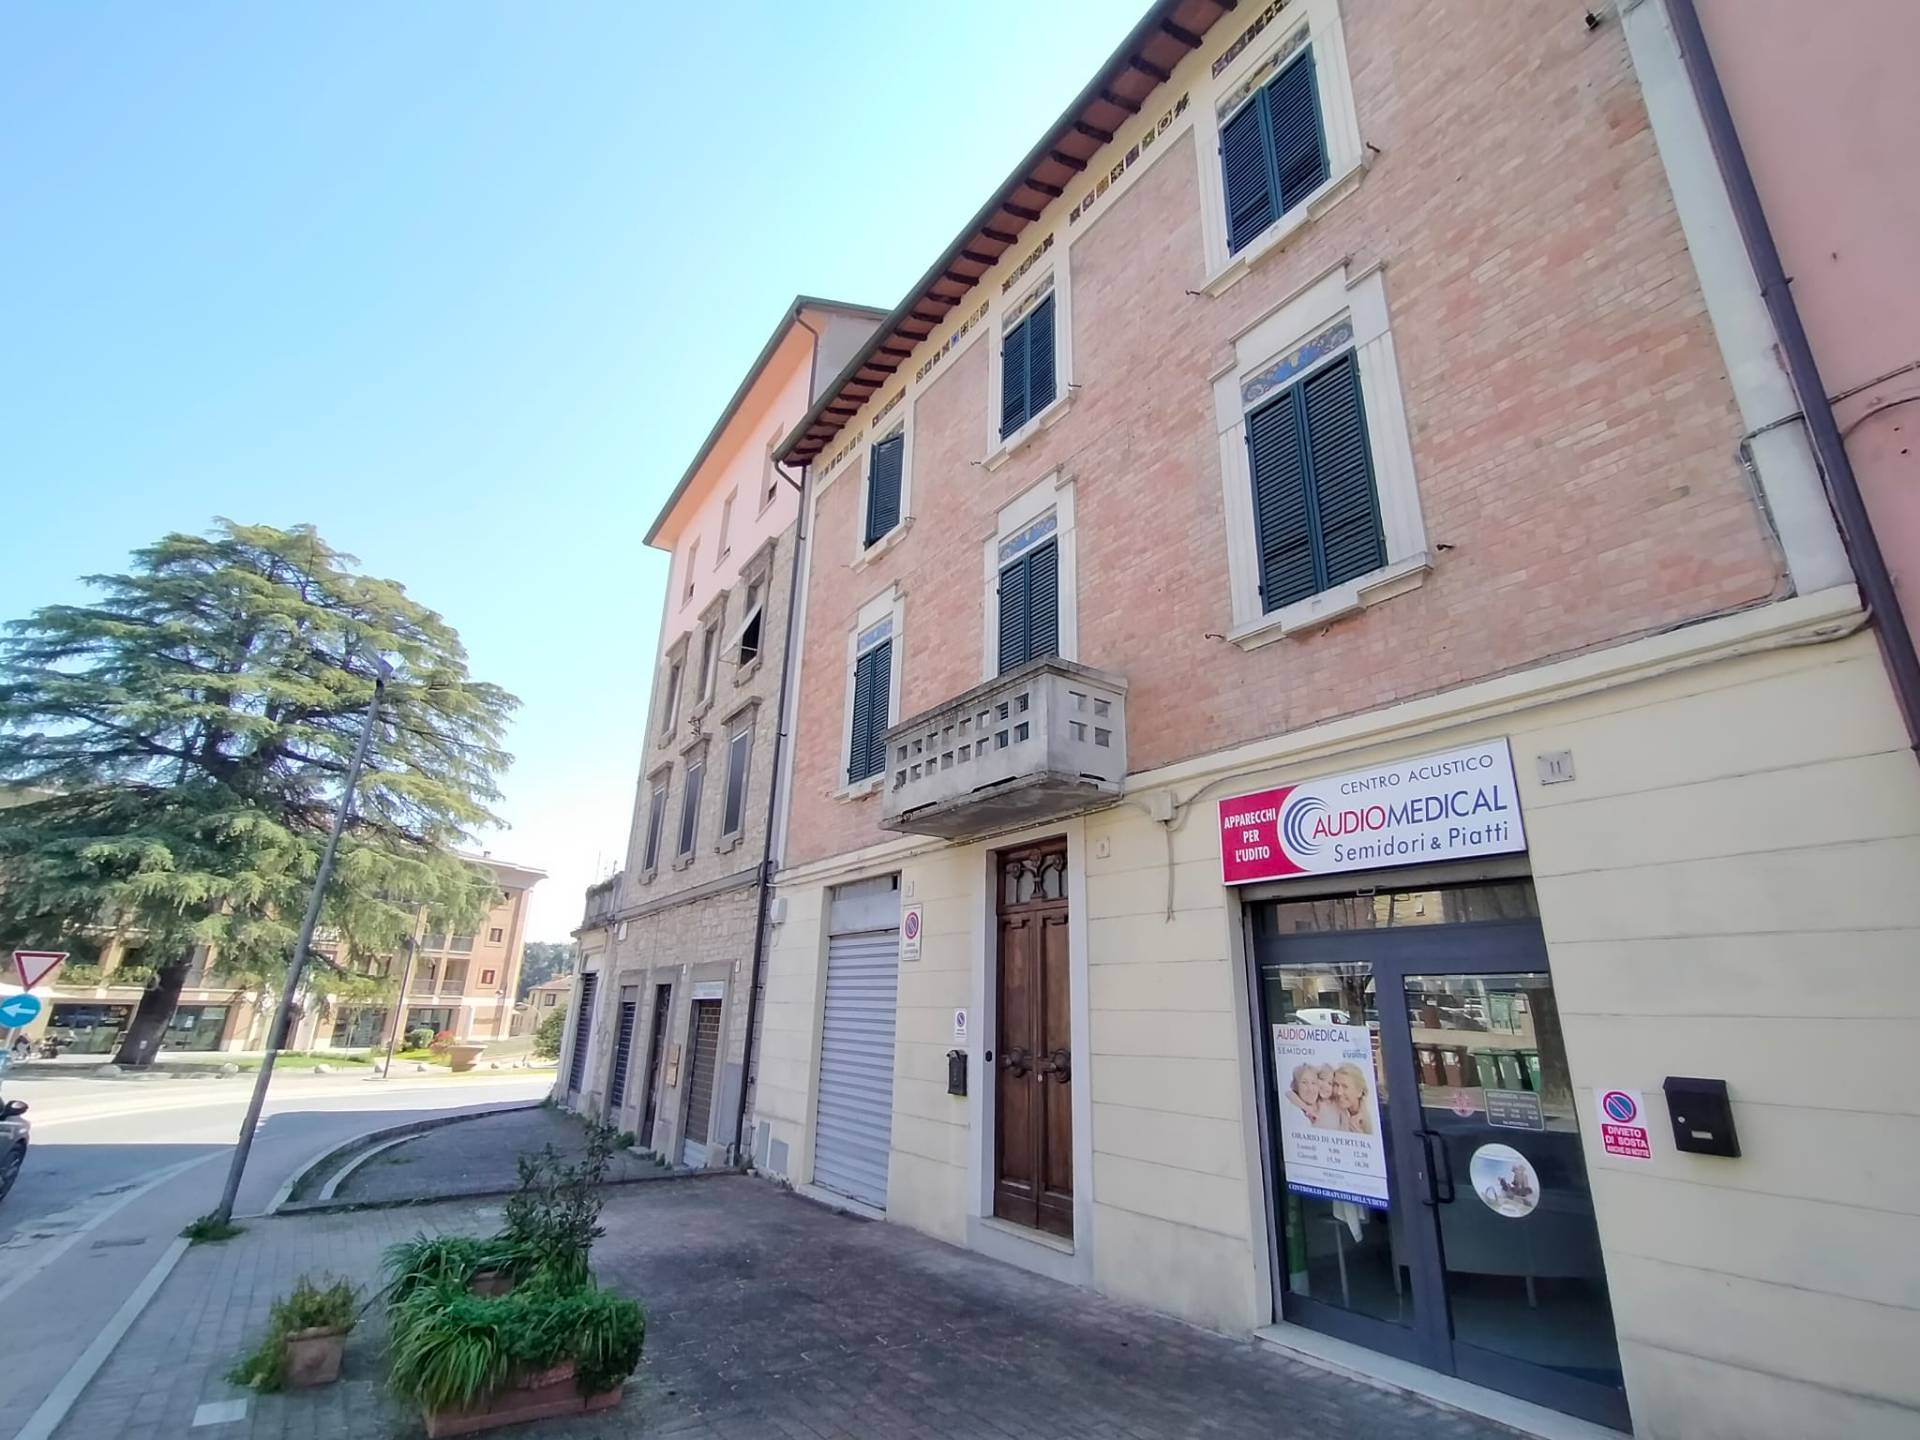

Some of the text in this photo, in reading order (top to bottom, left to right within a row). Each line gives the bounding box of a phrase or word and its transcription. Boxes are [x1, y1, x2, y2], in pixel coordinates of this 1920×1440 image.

[1340, 754, 1494, 795] CENTRO ACUSTICO
[1224, 807, 1276, 829] APPARECCHI
[1312, 785, 1508, 840] AUDIOMEDICAL
[1243, 829, 1260, 844] PER
[1334, 820, 1509, 863] Semidori & Piatti
[1235, 846, 1270, 863] L'UDITO
[1277, 1028, 1350, 1042] AUDIOMEDICAL
[1607, 1126, 1642, 1138] DIVIETO
[1605, 1135, 1648, 1149] DI SOSTA
